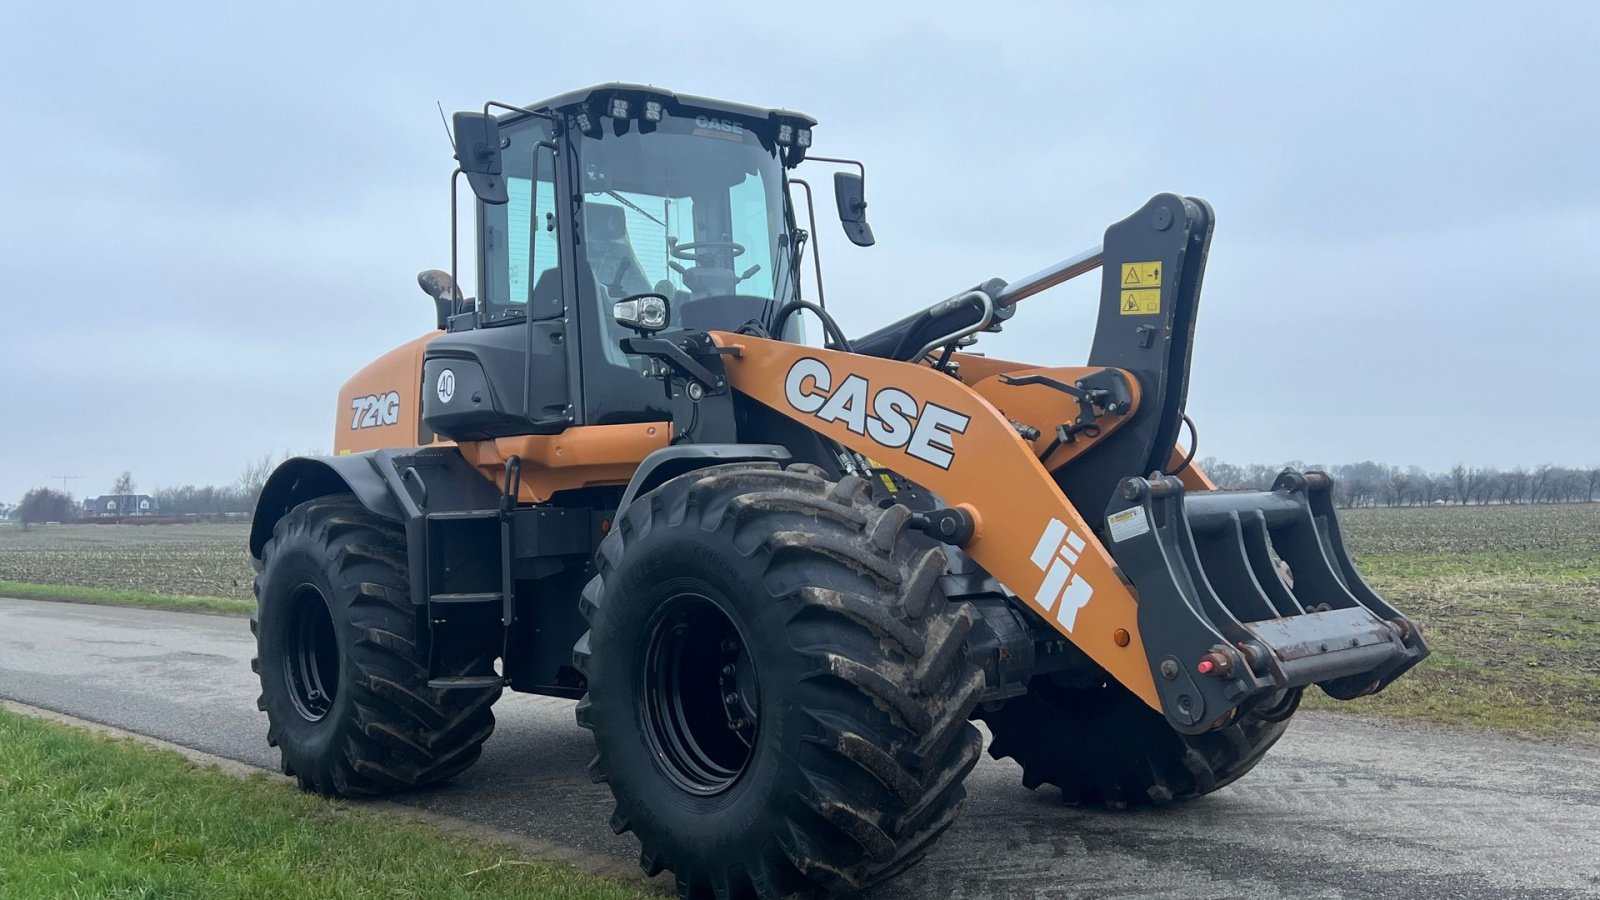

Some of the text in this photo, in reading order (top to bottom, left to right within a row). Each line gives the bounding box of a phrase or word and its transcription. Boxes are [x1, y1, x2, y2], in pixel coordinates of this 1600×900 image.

[695, 115, 744, 135] CASE
[439, 375, 452, 397] 40
[351, 391, 400, 430] 721G
[785, 357, 971, 471] CASE
